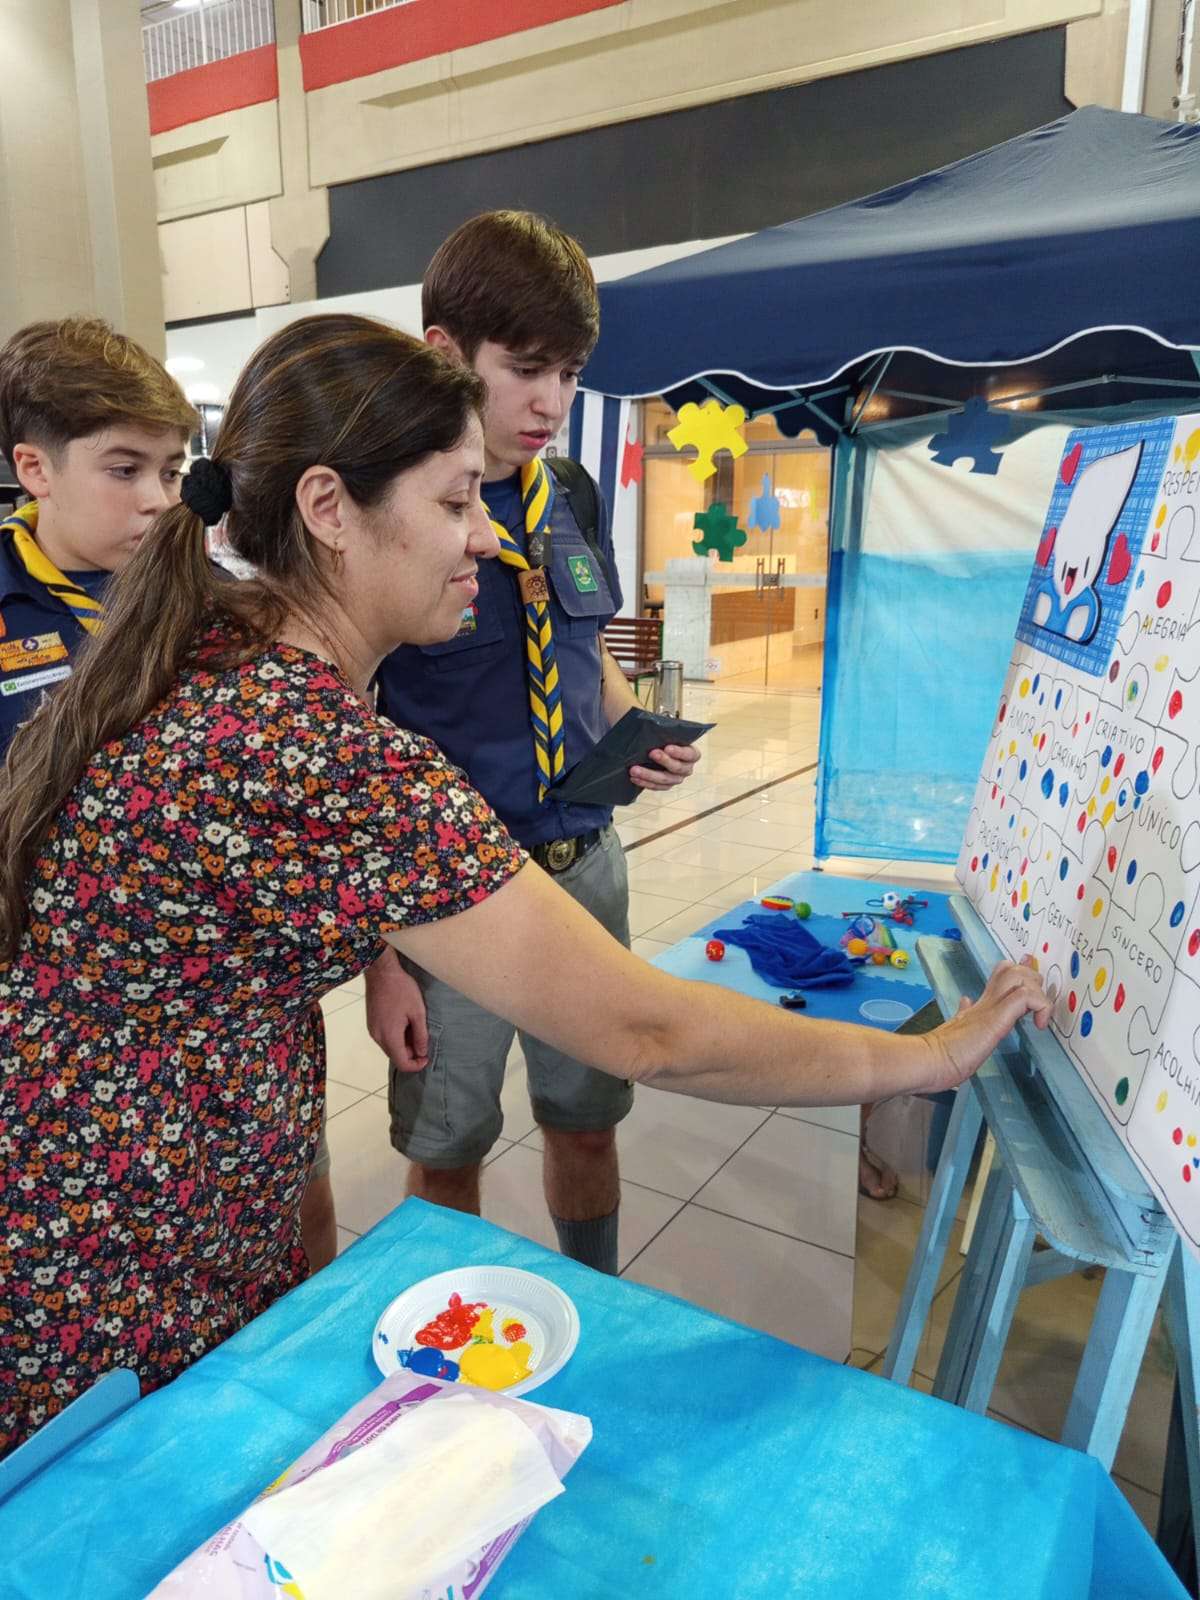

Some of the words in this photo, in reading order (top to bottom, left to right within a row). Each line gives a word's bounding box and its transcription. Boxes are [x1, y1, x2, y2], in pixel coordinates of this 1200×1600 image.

[1140, 613, 1187, 642] ALEGRIA
[1009, 705, 1036, 735] AMOR
[1095, 718, 1145, 754] CRIATIVO
[1050, 741, 1088, 780] CARINHO
[1138, 794, 1182, 850] ÚNICO
[999, 902, 1031, 947] CUIDADO
[1047, 902, 1095, 966] GENTILEZA
[1111, 925, 1163, 984] SINCERO
